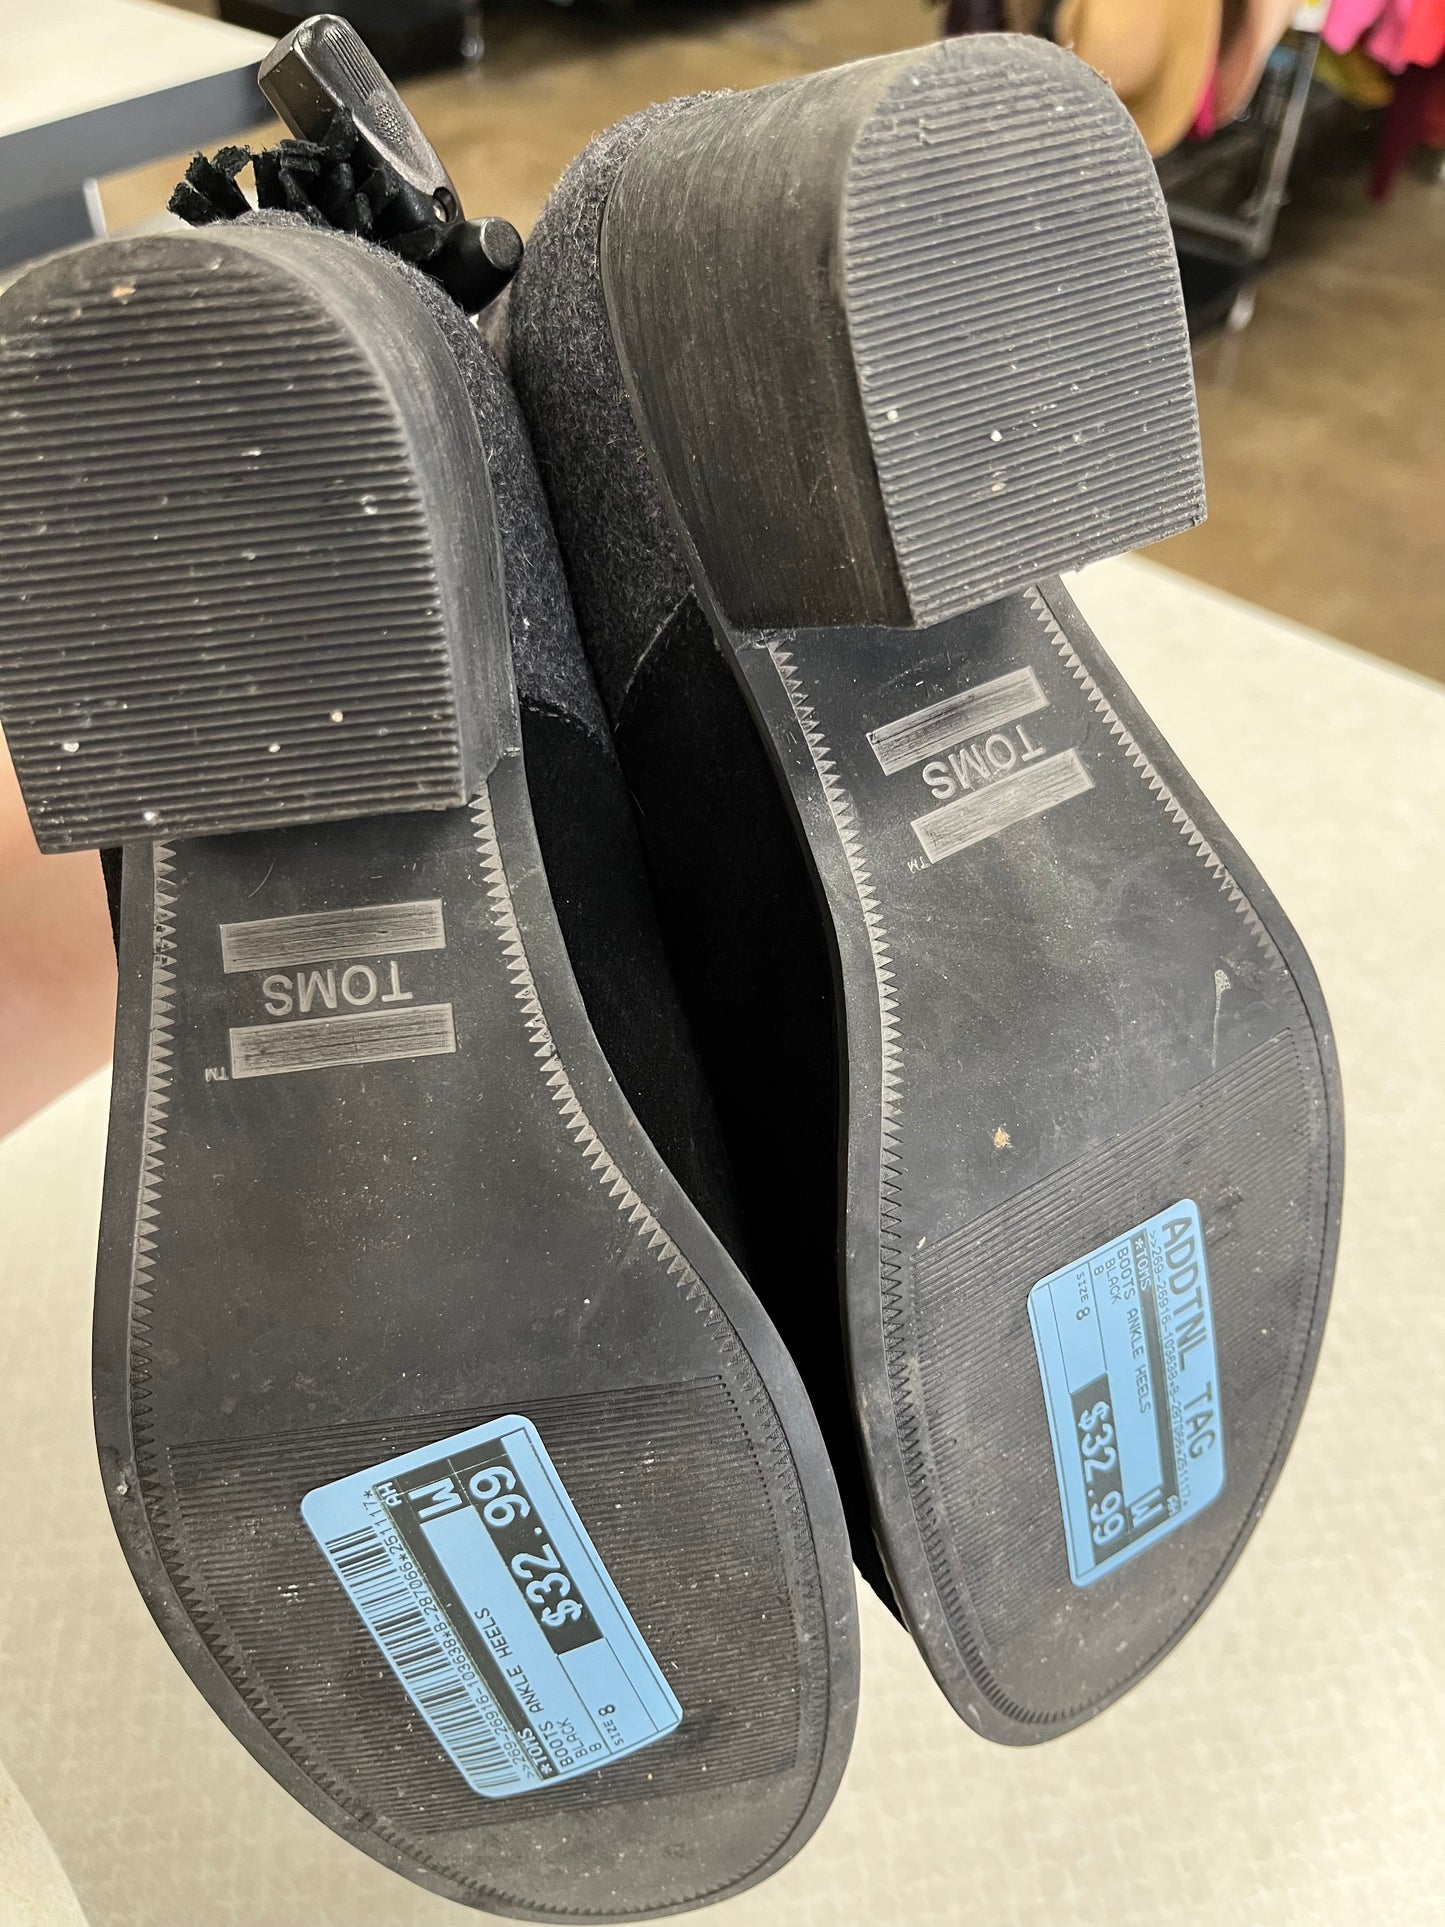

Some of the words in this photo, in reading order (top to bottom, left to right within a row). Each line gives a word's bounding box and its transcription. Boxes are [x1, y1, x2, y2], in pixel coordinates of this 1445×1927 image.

[926, 724, 1046, 800] TOMS
[262, 961, 413, 1017] TOMS
[204, 1066, 229, 1083] TM
[1075, 1272, 1089, 1302] SIZE
[1093, 1264, 1104, 1276] 8
[1103, 1257, 1121, 1304] BLACK
[1116, 1246, 1135, 1300] BOOTS
[1160, 1215, 1208, 1371] ADDTNL
[1075, 1305, 1090, 1320] 8
[1126, 1307, 1143, 1359] ANKLE
[1133, 1364, 1151, 1414] HEELS
[1183, 1380, 1217, 1458] TAG
[376, 1481, 403, 1505] AH
[407, 1475, 463, 1519] W
[1077, 1400, 1125, 1546] $32.99
[1130, 1487, 1163, 1528] W
[467, 1465, 582, 1627] $32.99
[472, 1606, 513, 1658] HEELS
[505, 1664, 544, 1713] ANKLE
[598, 1703, 615, 1716] 8
[537, 1719, 574, 1768] BOOTS
[555, 1716, 589, 1759] BLACK
[588, 1741, 601, 1752] 8
[602, 1718, 624, 1745] SIZE
